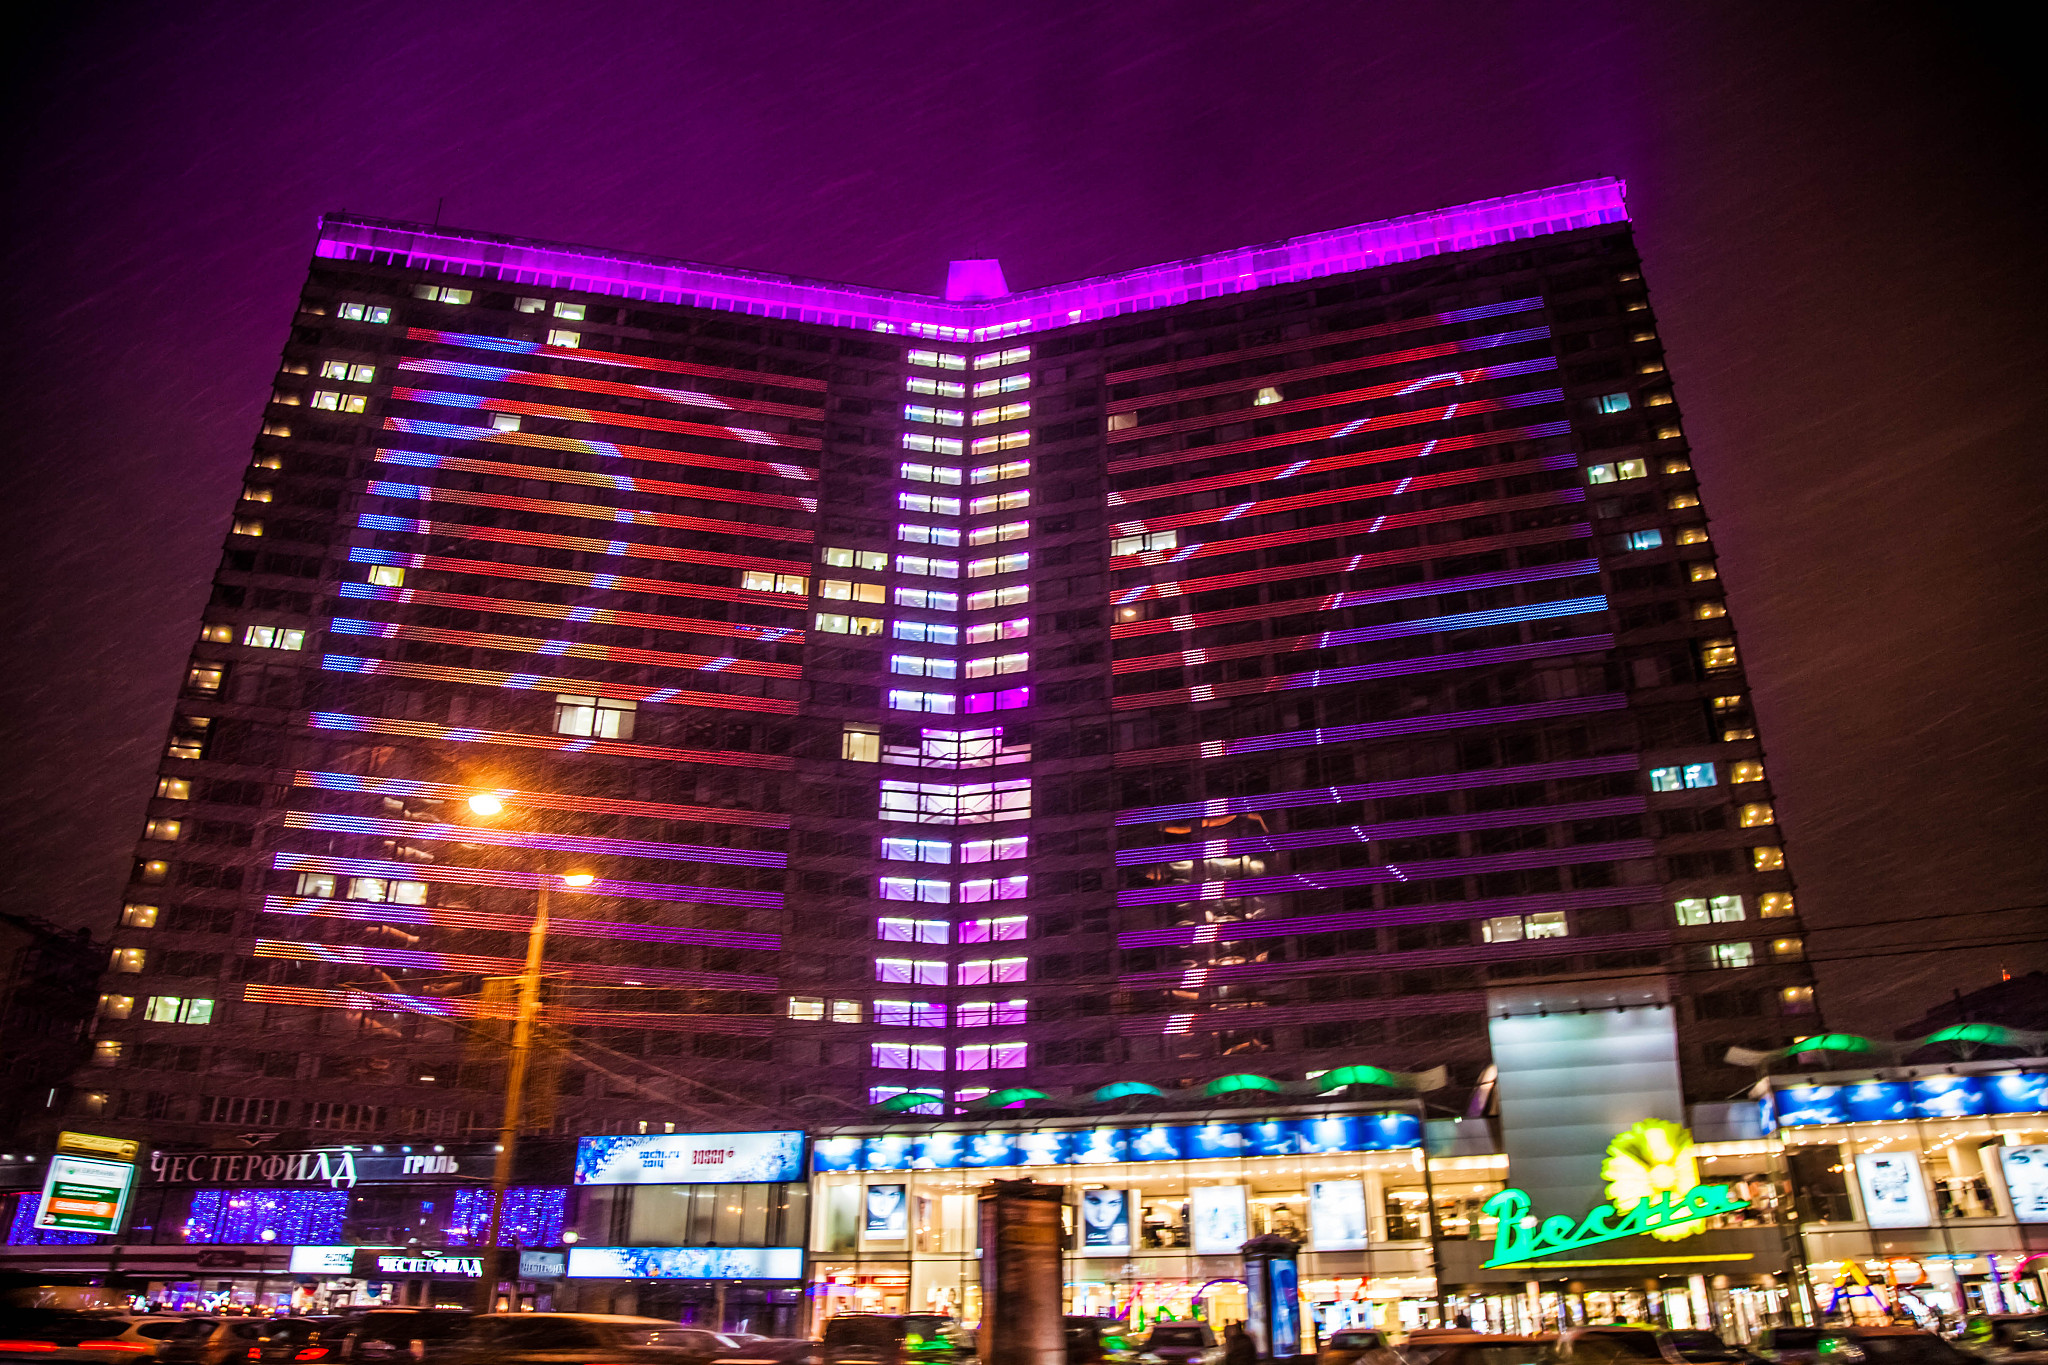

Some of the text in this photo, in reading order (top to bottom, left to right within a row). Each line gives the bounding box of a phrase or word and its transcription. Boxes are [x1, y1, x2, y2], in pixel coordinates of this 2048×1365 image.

[151, 1152, 358, 1188] ЧЕСТЕРФИЛД
[403, 1155, 458, 1174] ГРИЛЬ
[642, 1160, 664, 1168] 2014
[378, 1257, 483, 1277] ЧЕСТЕРФИЛД
